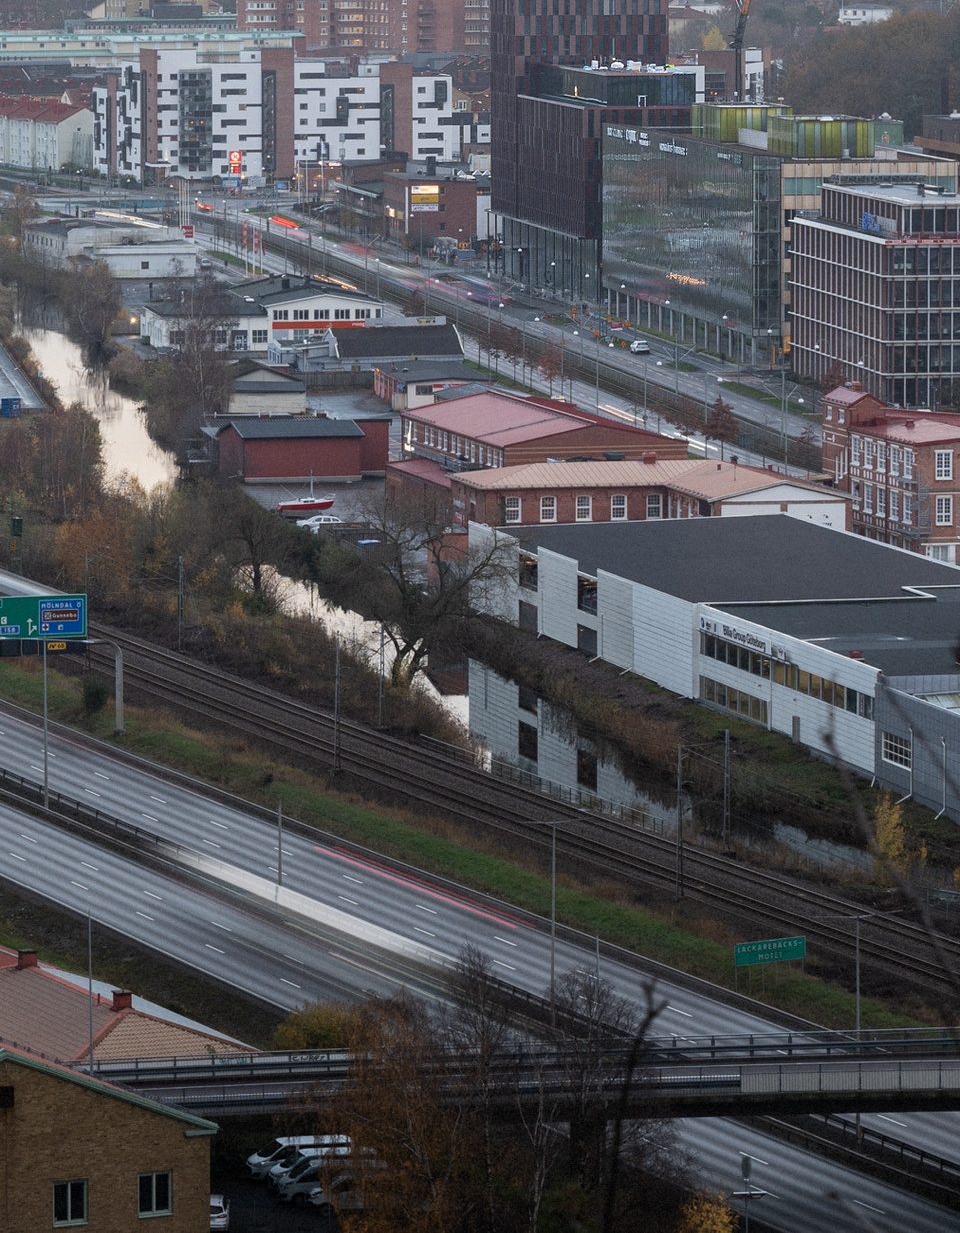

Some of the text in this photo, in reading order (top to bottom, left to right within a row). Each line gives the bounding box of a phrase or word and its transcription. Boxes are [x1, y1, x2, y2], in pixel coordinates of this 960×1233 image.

[41, 601, 73, 609] MÖLNDAL
[733, 628, 746, 644] Group
[746, 633, 766, 652] Göteborg
[737, 940, 803, 954] LACKAREBÄCKS-
[758, 952, 784, 960] MOTET
